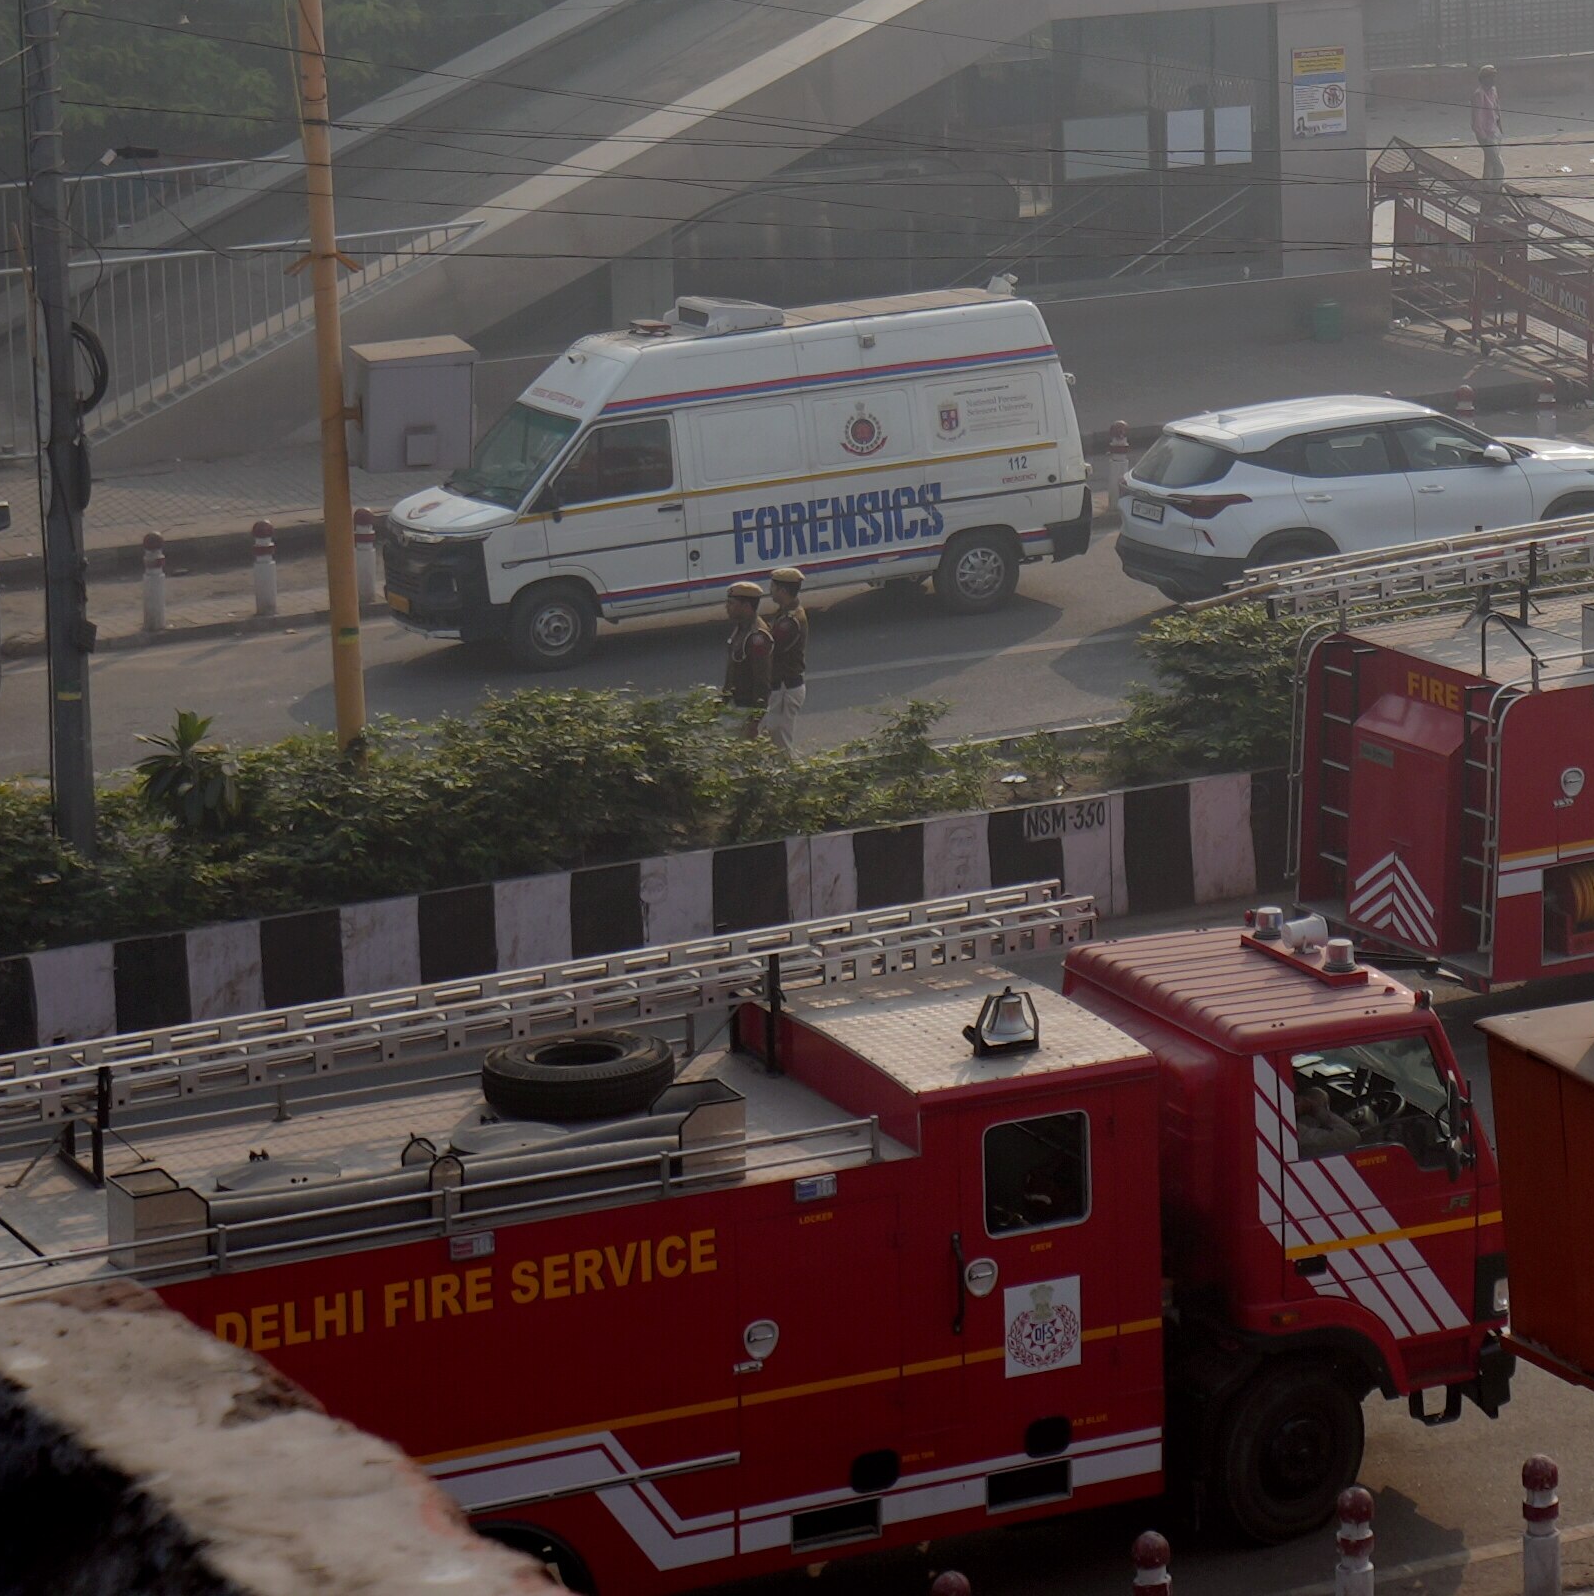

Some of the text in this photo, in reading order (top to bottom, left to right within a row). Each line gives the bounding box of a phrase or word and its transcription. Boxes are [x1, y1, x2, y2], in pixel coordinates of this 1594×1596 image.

[1529, 275, 1554, 300] DELHI
[1008, 455, 1028, 471] 112
[733, 482, 945, 565] FORENSICS
[1406, 670, 1461, 712] FIRE
[1026, 801, 1106, 837] NSM-350
[1356, 1155, 1388, 1167] DRIVER
[798, 1211, 834, 1225] LOCKER
[1029, 1241, 1054, 1254] CREW
[214, 1228, 718, 1353] DELHI FIRE SERVICE
[1034, 1323, 1054, 1344] DFS
[1085, 1413, 1109, 1425] BLUE
